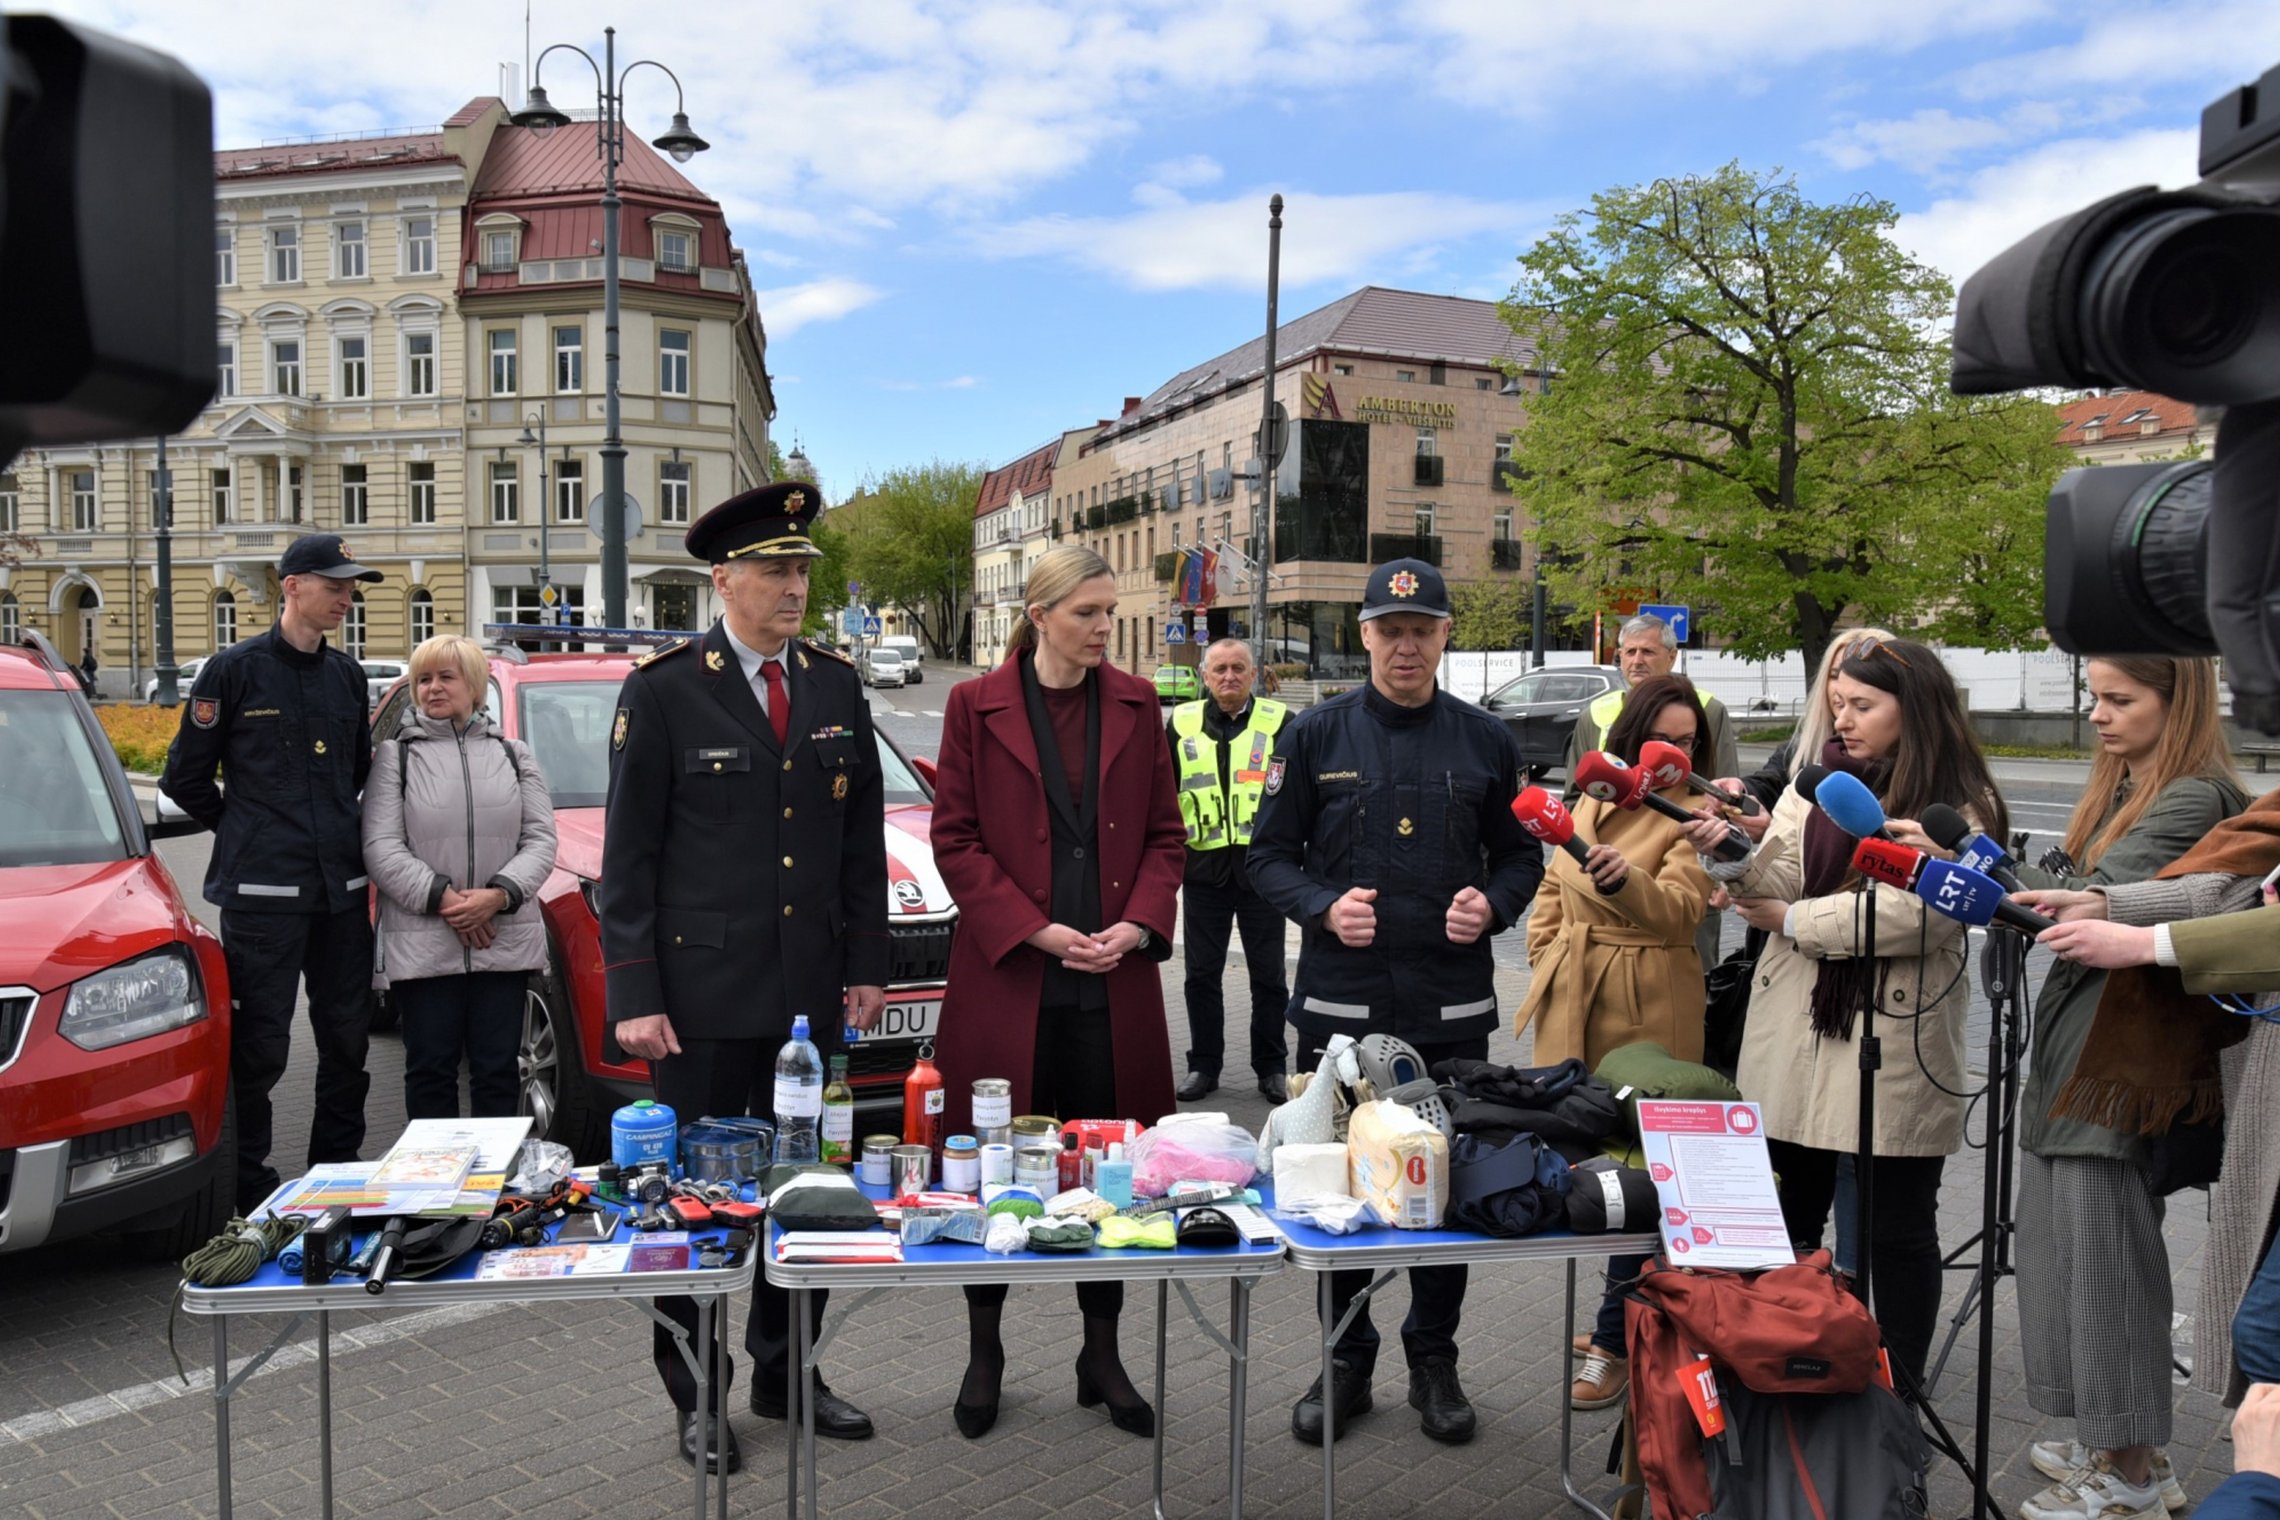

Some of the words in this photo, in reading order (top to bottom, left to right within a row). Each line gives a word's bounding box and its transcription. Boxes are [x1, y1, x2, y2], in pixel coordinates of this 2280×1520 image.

[1358, 395, 1457, 416] AMBERTON
[1358, 411, 1393, 425] HOTEL
[1406, 414, 1456, 430] VIEŠBUTIS
[1455, 658, 1514, 667] POOLSRVICE
[1861, 853, 1905, 878] rytas
[1935, 870, 1966, 912] LRT
[1968, 886, 1977, 896] TV
[844, 1027, 857, 1037] LT
[625, 1129, 673, 1141] CAMPINGAZ
